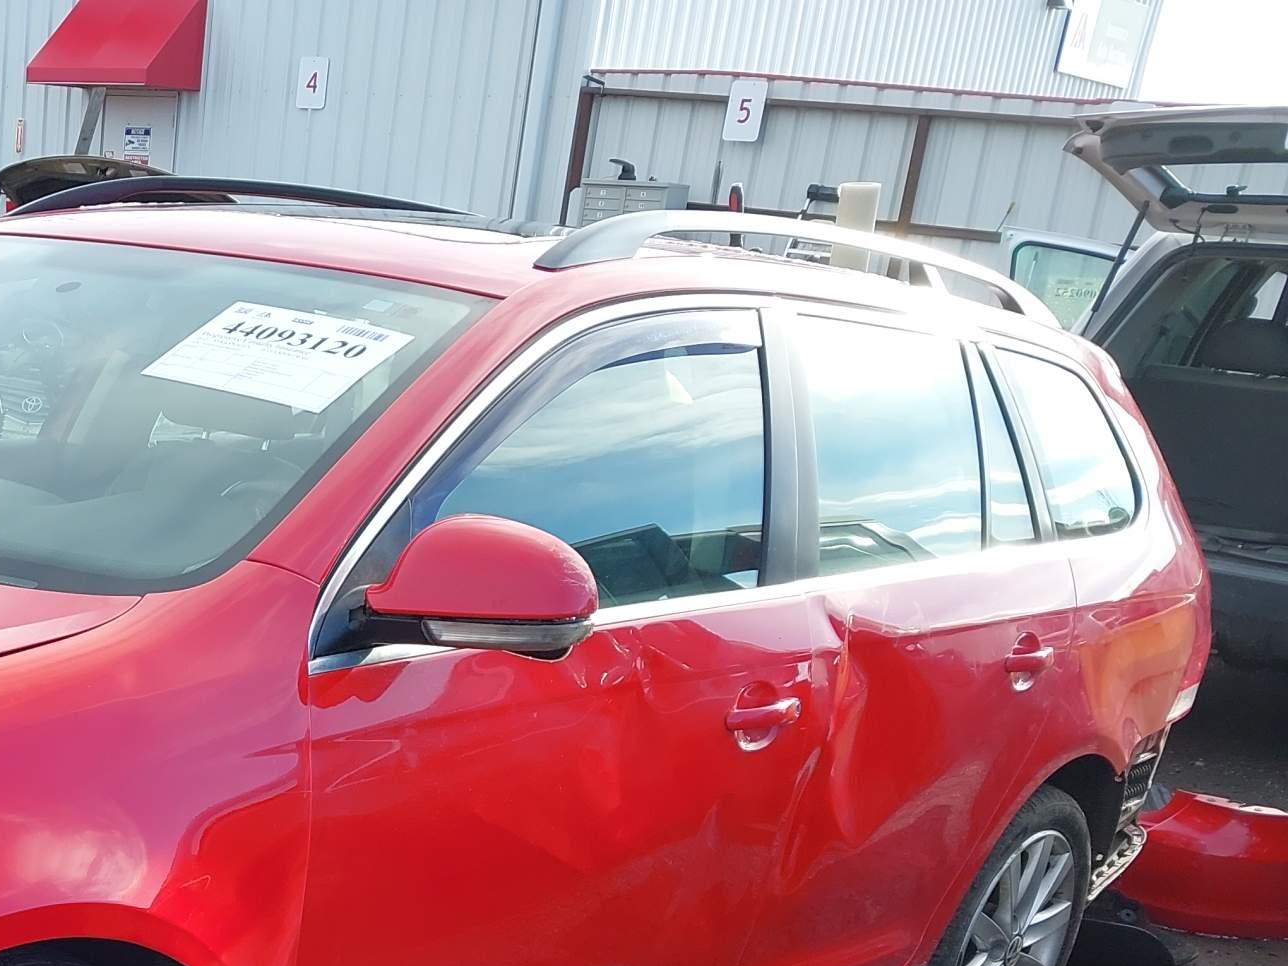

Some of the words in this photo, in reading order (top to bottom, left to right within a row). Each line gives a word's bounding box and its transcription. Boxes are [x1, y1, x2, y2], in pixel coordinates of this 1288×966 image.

[305, 71, 318, 94] 4
[736, 98, 752, 124] 5
[222, 320, 368, 359] 44093120
